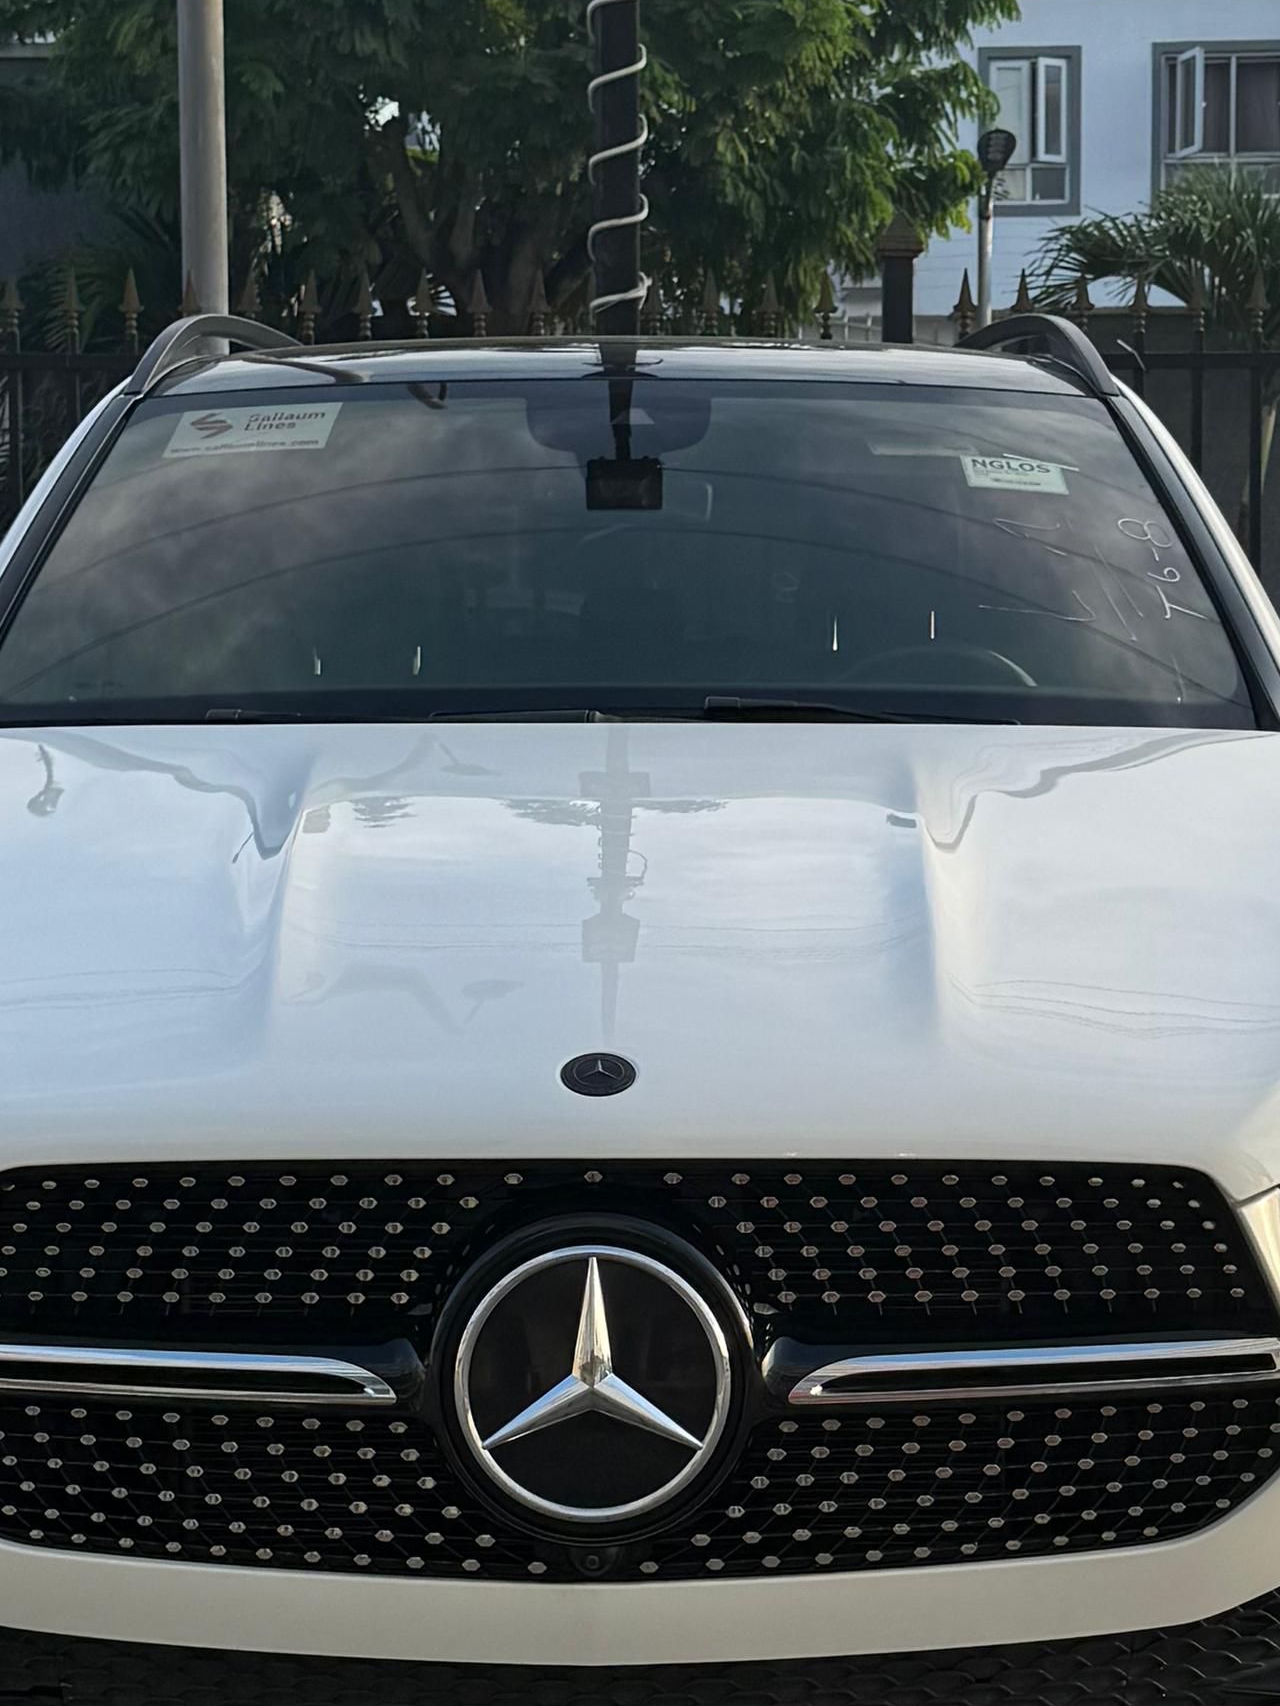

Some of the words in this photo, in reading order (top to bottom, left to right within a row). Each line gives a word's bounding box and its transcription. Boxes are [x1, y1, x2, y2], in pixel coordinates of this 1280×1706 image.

[248, 411, 326, 423] Sallaum
[244, 421, 297, 432] Lines
[971, 458, 1051, 474] NGLOS
